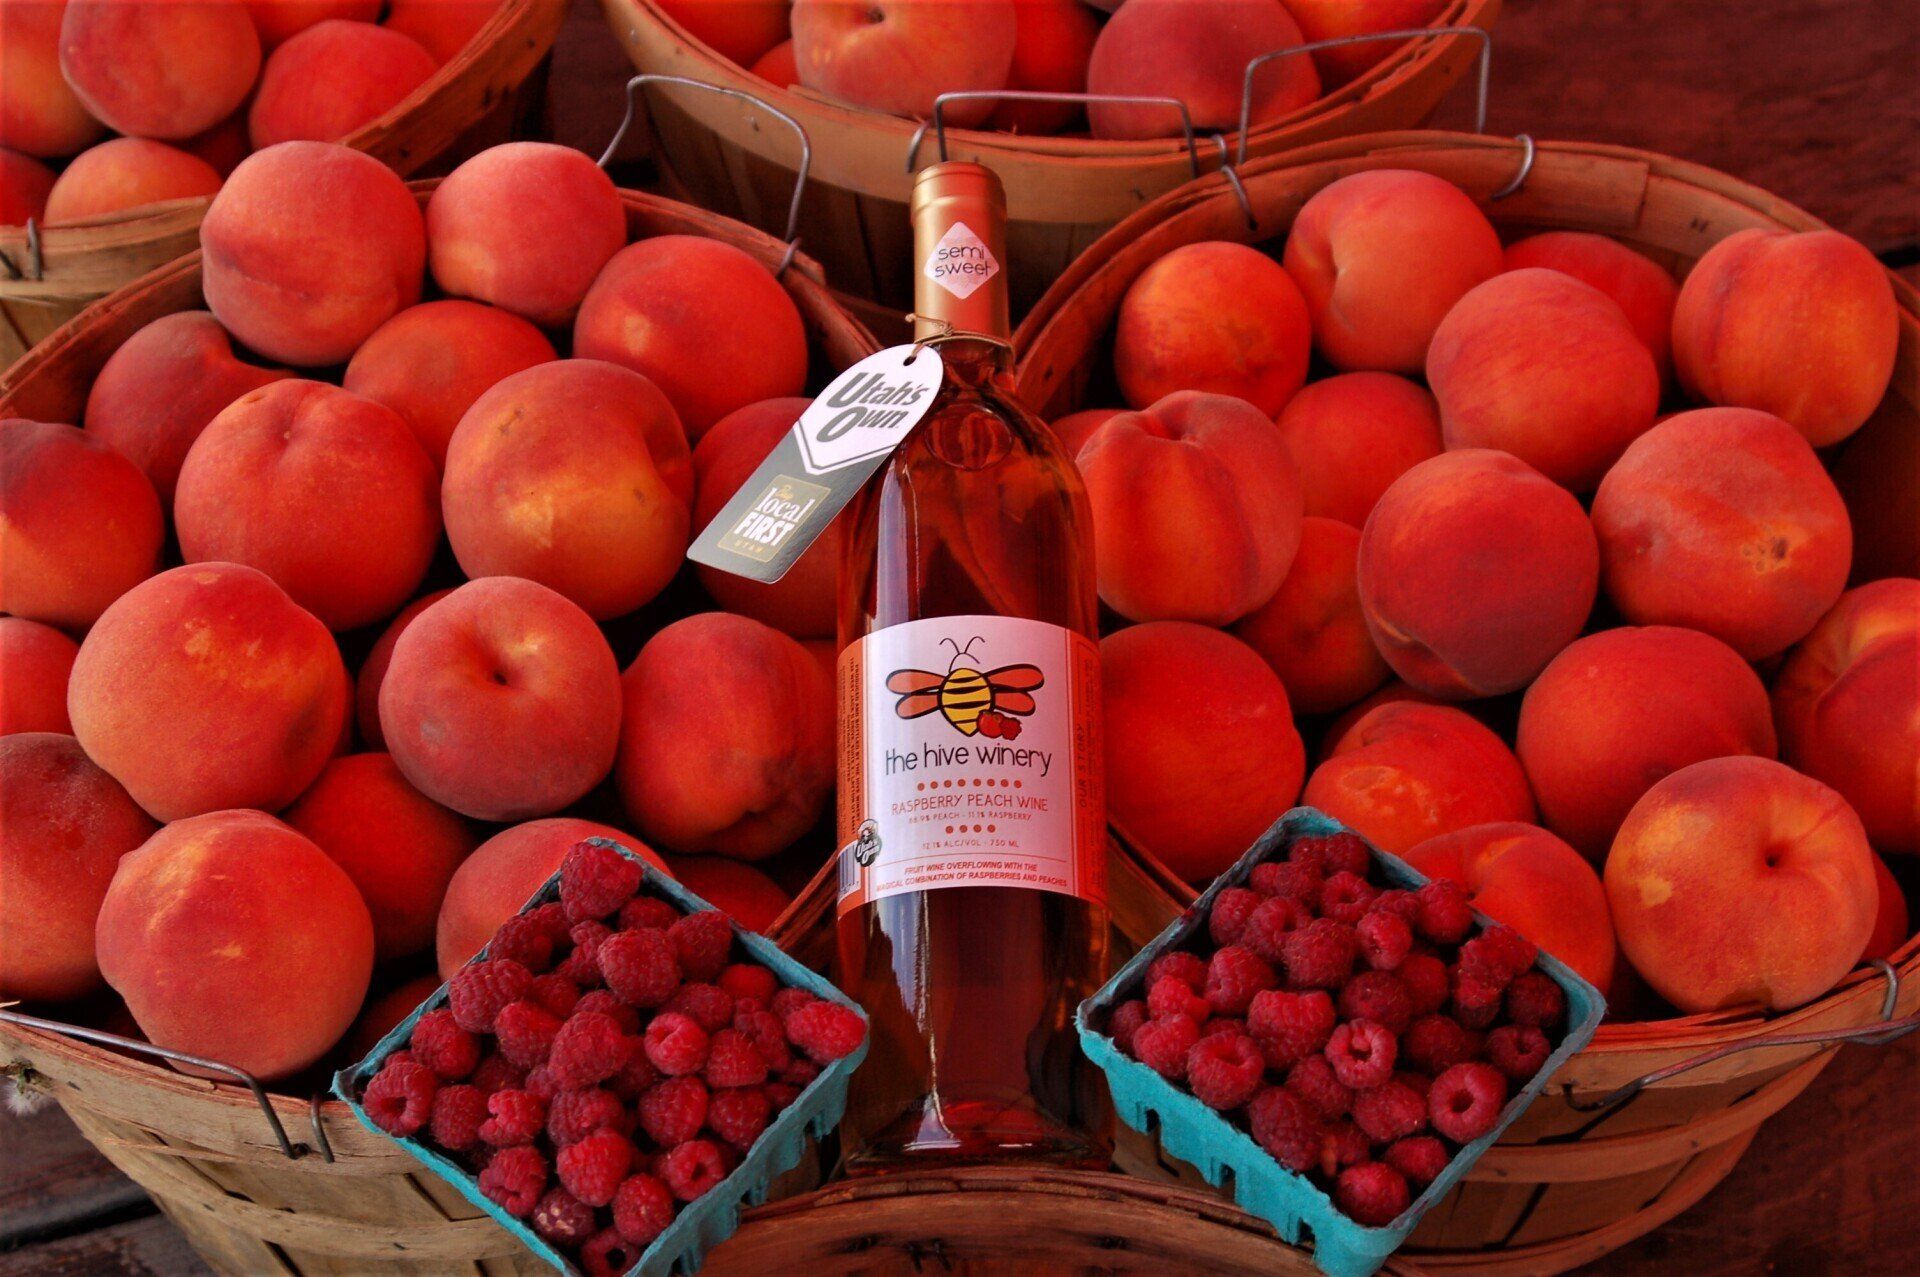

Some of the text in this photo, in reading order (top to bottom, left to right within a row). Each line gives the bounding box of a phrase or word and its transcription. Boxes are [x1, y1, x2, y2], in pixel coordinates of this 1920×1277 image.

[938, 246, 984, 260] semi
[935, 261, 991, 277] sweet
[826, 372, 929, 408] Utah's
[816, 406, 909, 442] Own
[755, 487, 816, 522] local
[733, 511, 795, 546] FIRST
[886, 742, 1052, 777] the hive winery
[891, 794, 1049, 816] RASPBERRY PEACH WINE
[933, 812, 960, 820] PEACH
[988, 811, 1032, 821] RASPBERRY
[944, 840, 981, 848] ALC/VOL
[990, 839, 1006, 847] 750
[1008, 840, 1020, 848] ML
[904, 861, 1038, 875] FRUIT WINE OVERFLOWING WITH THE
[876, 871, 1067, 893] MAGICAL COMBINATION OF RASPBERRIES AND PEACHES
